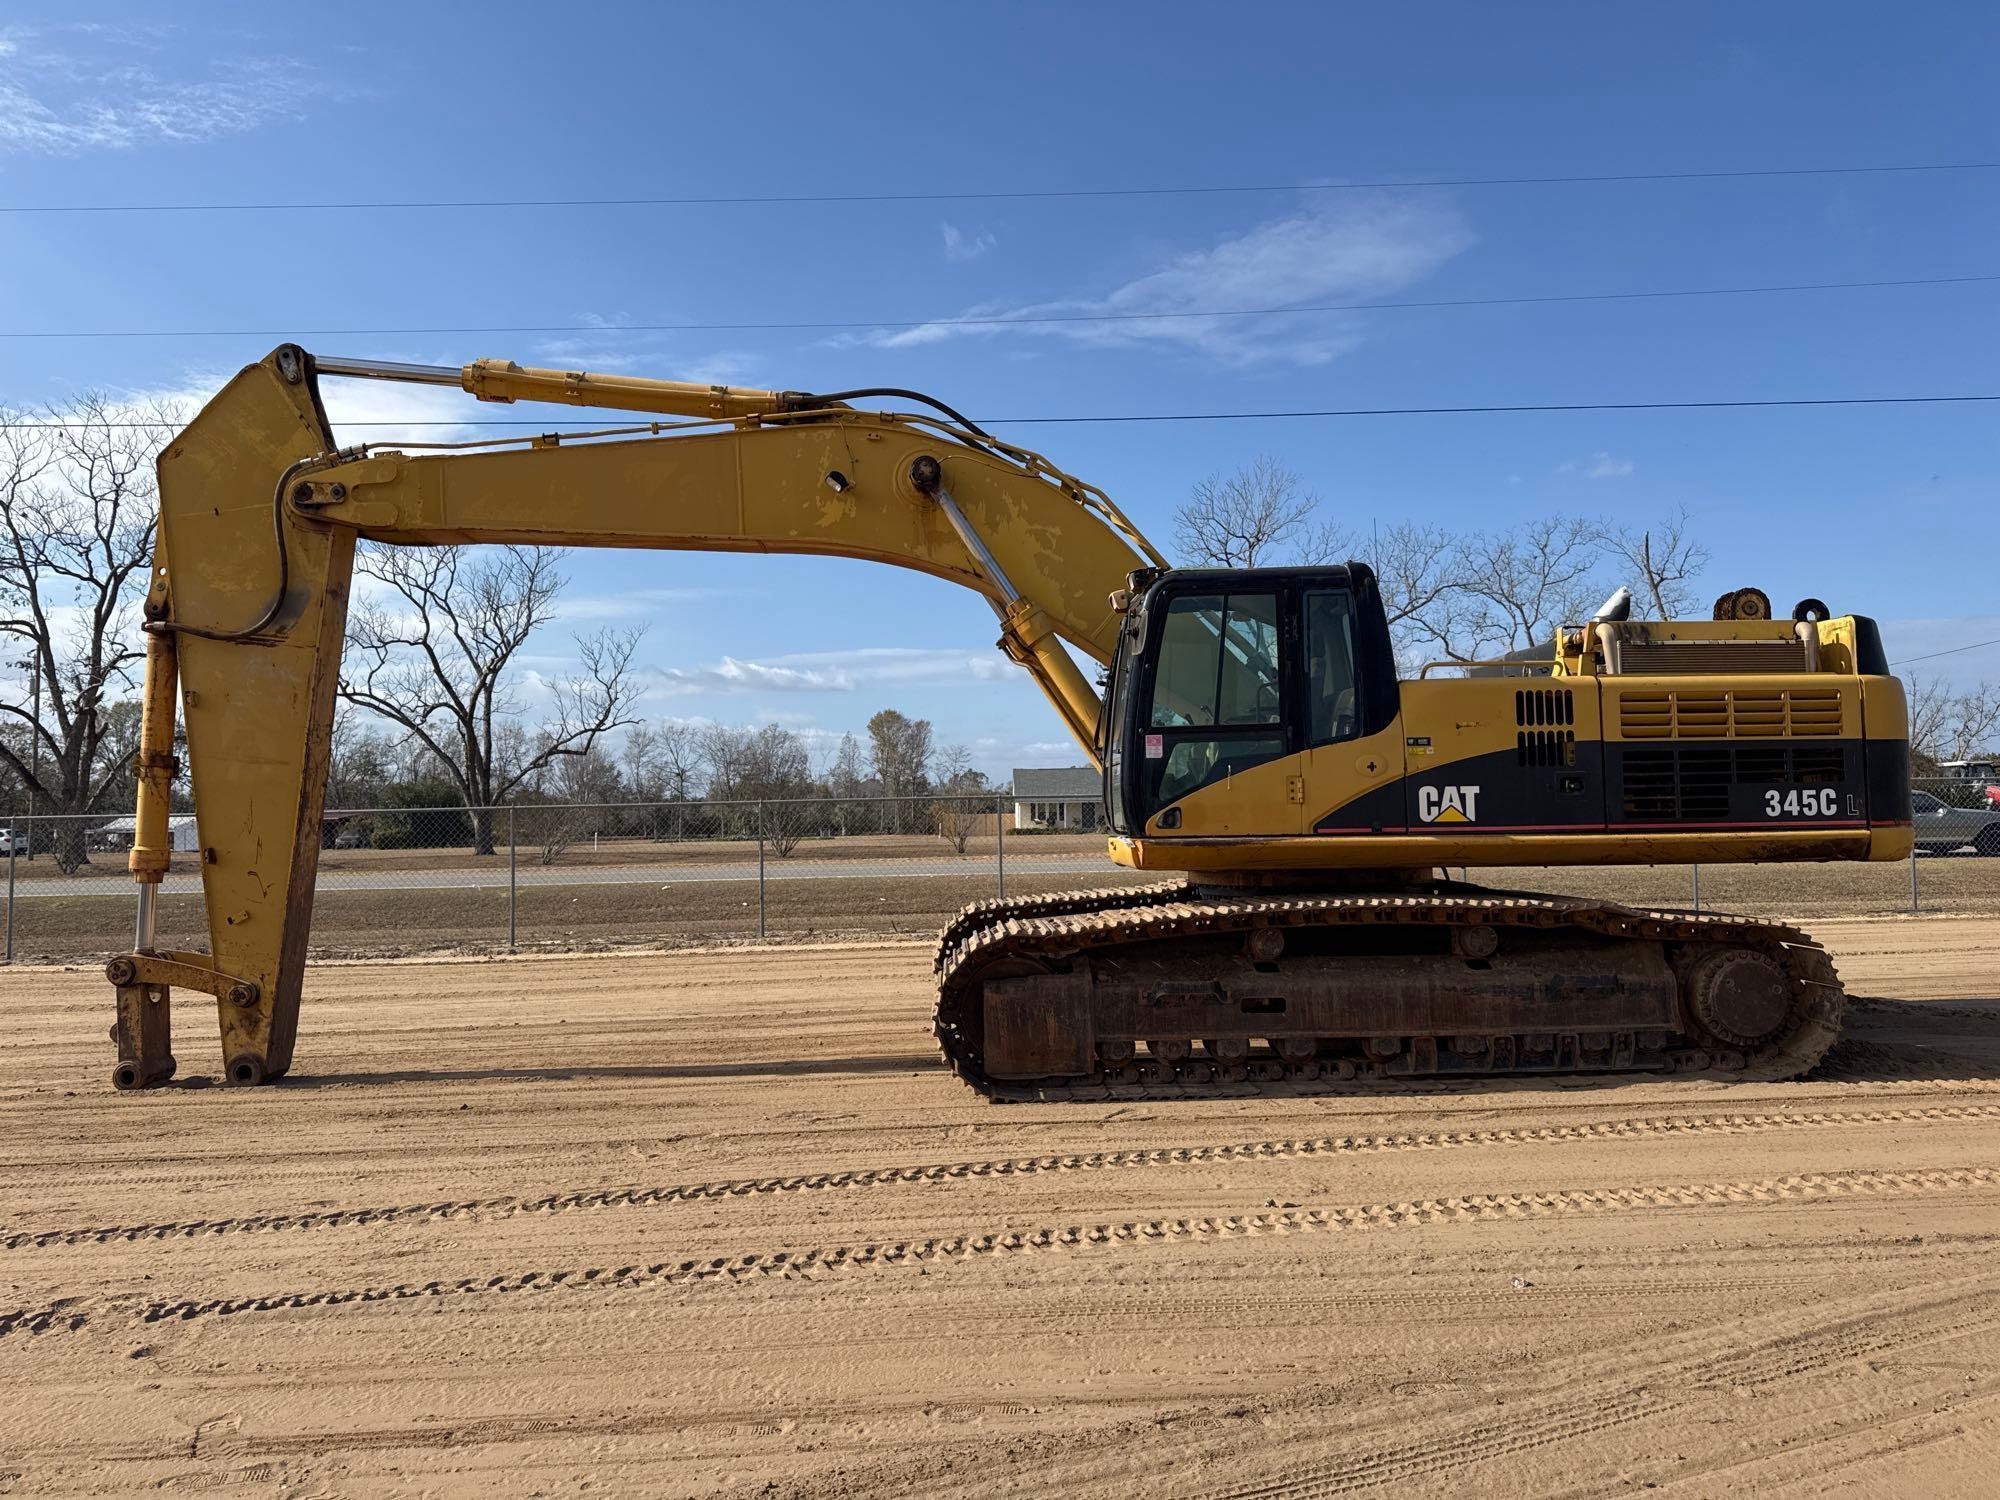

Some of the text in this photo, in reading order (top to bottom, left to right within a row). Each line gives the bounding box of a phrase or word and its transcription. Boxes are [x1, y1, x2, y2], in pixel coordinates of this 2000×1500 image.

[1418, 785, 1480, 823] CAT
[1764, 788, 1860, 817] 345C L
